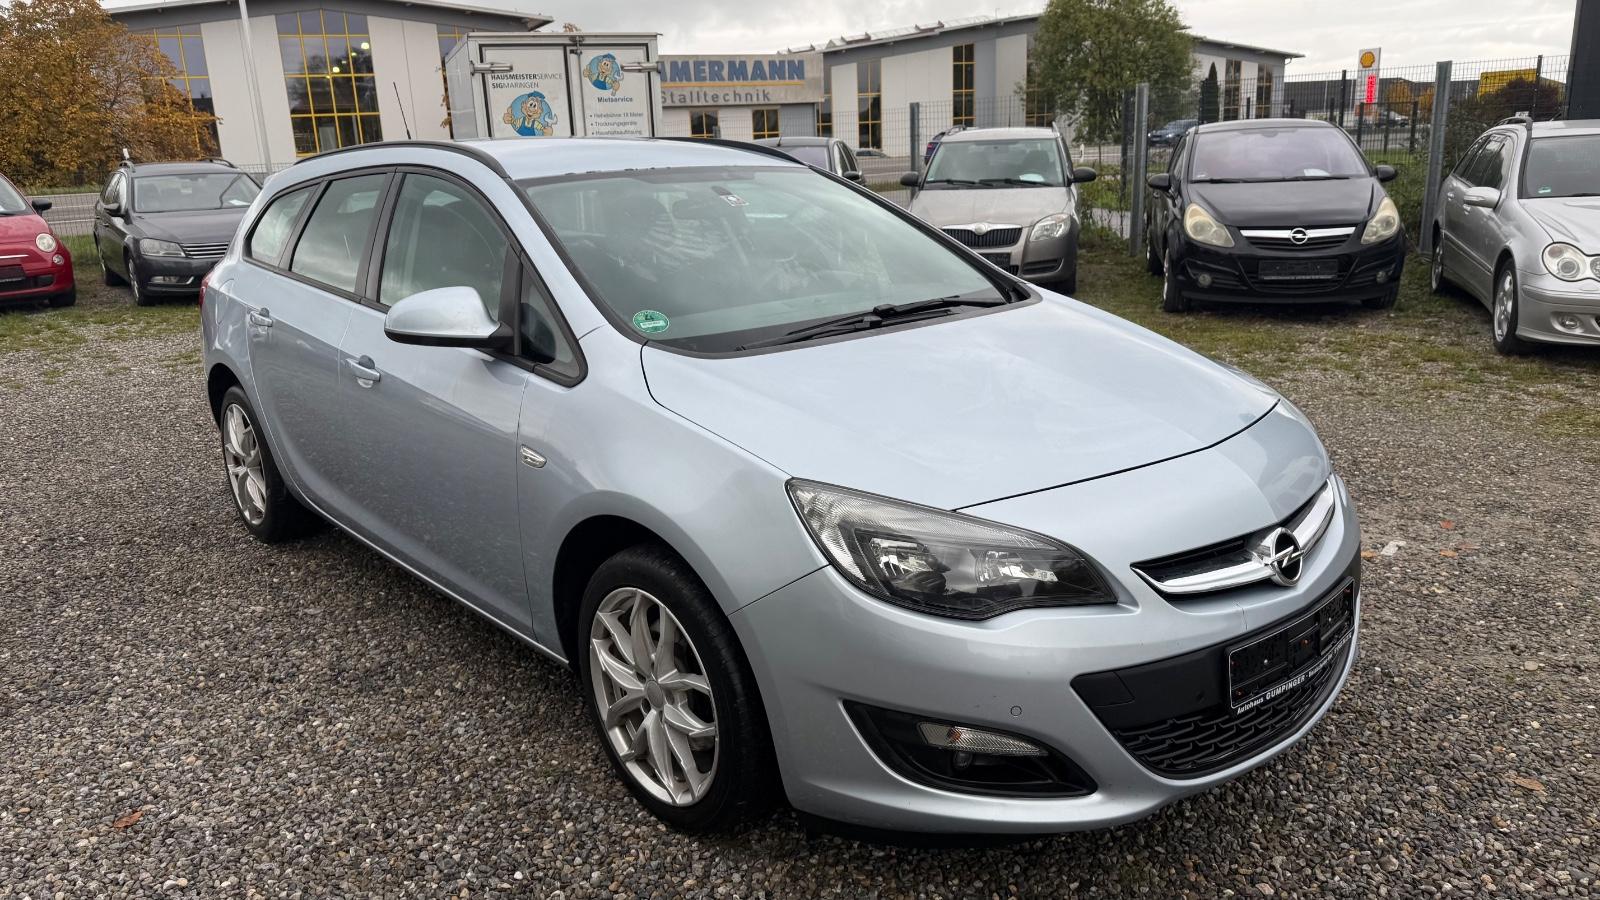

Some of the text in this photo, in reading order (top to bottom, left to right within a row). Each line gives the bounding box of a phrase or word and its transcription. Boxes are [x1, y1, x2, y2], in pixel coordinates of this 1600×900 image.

[661, 89, 770, 104] Stalltechnik
[1237, 674, 1305, 716] Autohaus GUMPINGER
